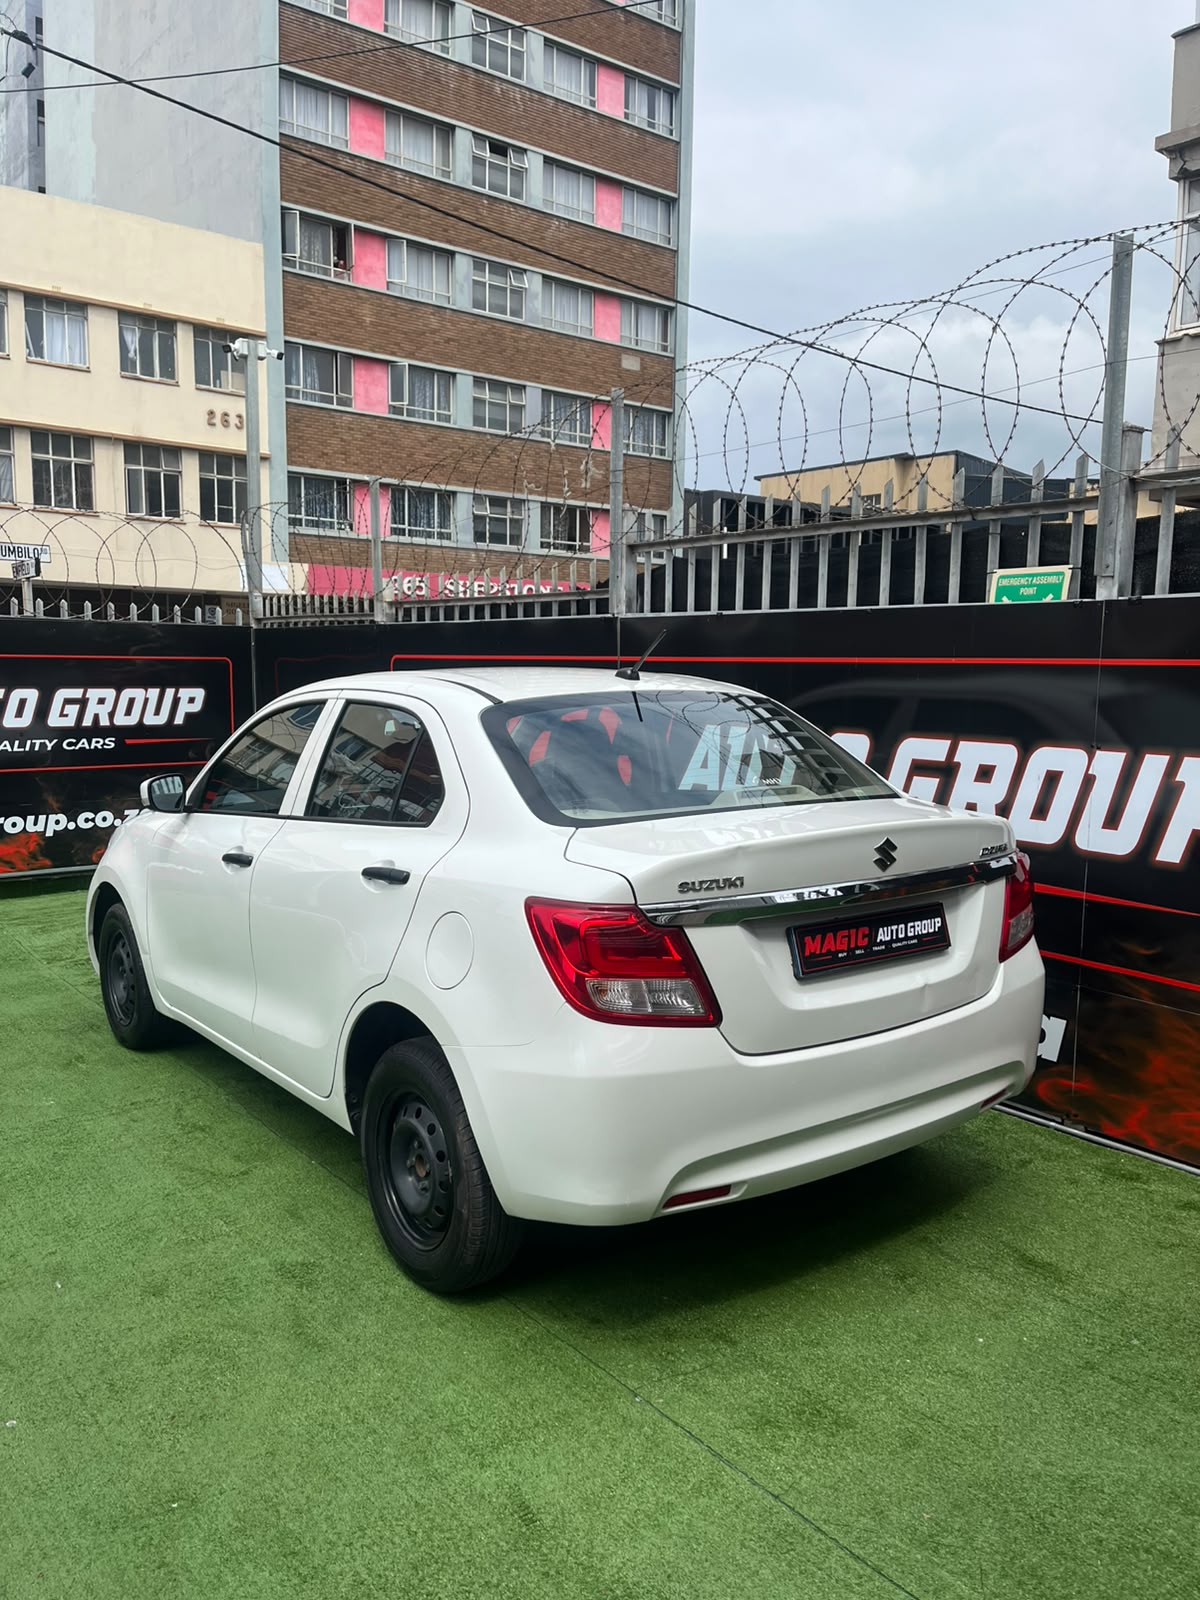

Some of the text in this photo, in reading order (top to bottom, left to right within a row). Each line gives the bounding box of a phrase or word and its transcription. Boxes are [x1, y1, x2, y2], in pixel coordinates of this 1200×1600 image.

[207, 409, 244, 430] 263
[0, 544, 40, 559] UMBILO
[998, 575, 1064, 586] EMERGENCY ASSEMBLY
[1020, 587, 1037, 595] POINT
[0, 688, 206, 728] O GROUP
[62, 737, 116, 750] CARS
[678, 876, 744, 894] SUZUKI
[804, 917, 942, 957] MAGIC AUTO GROUP
